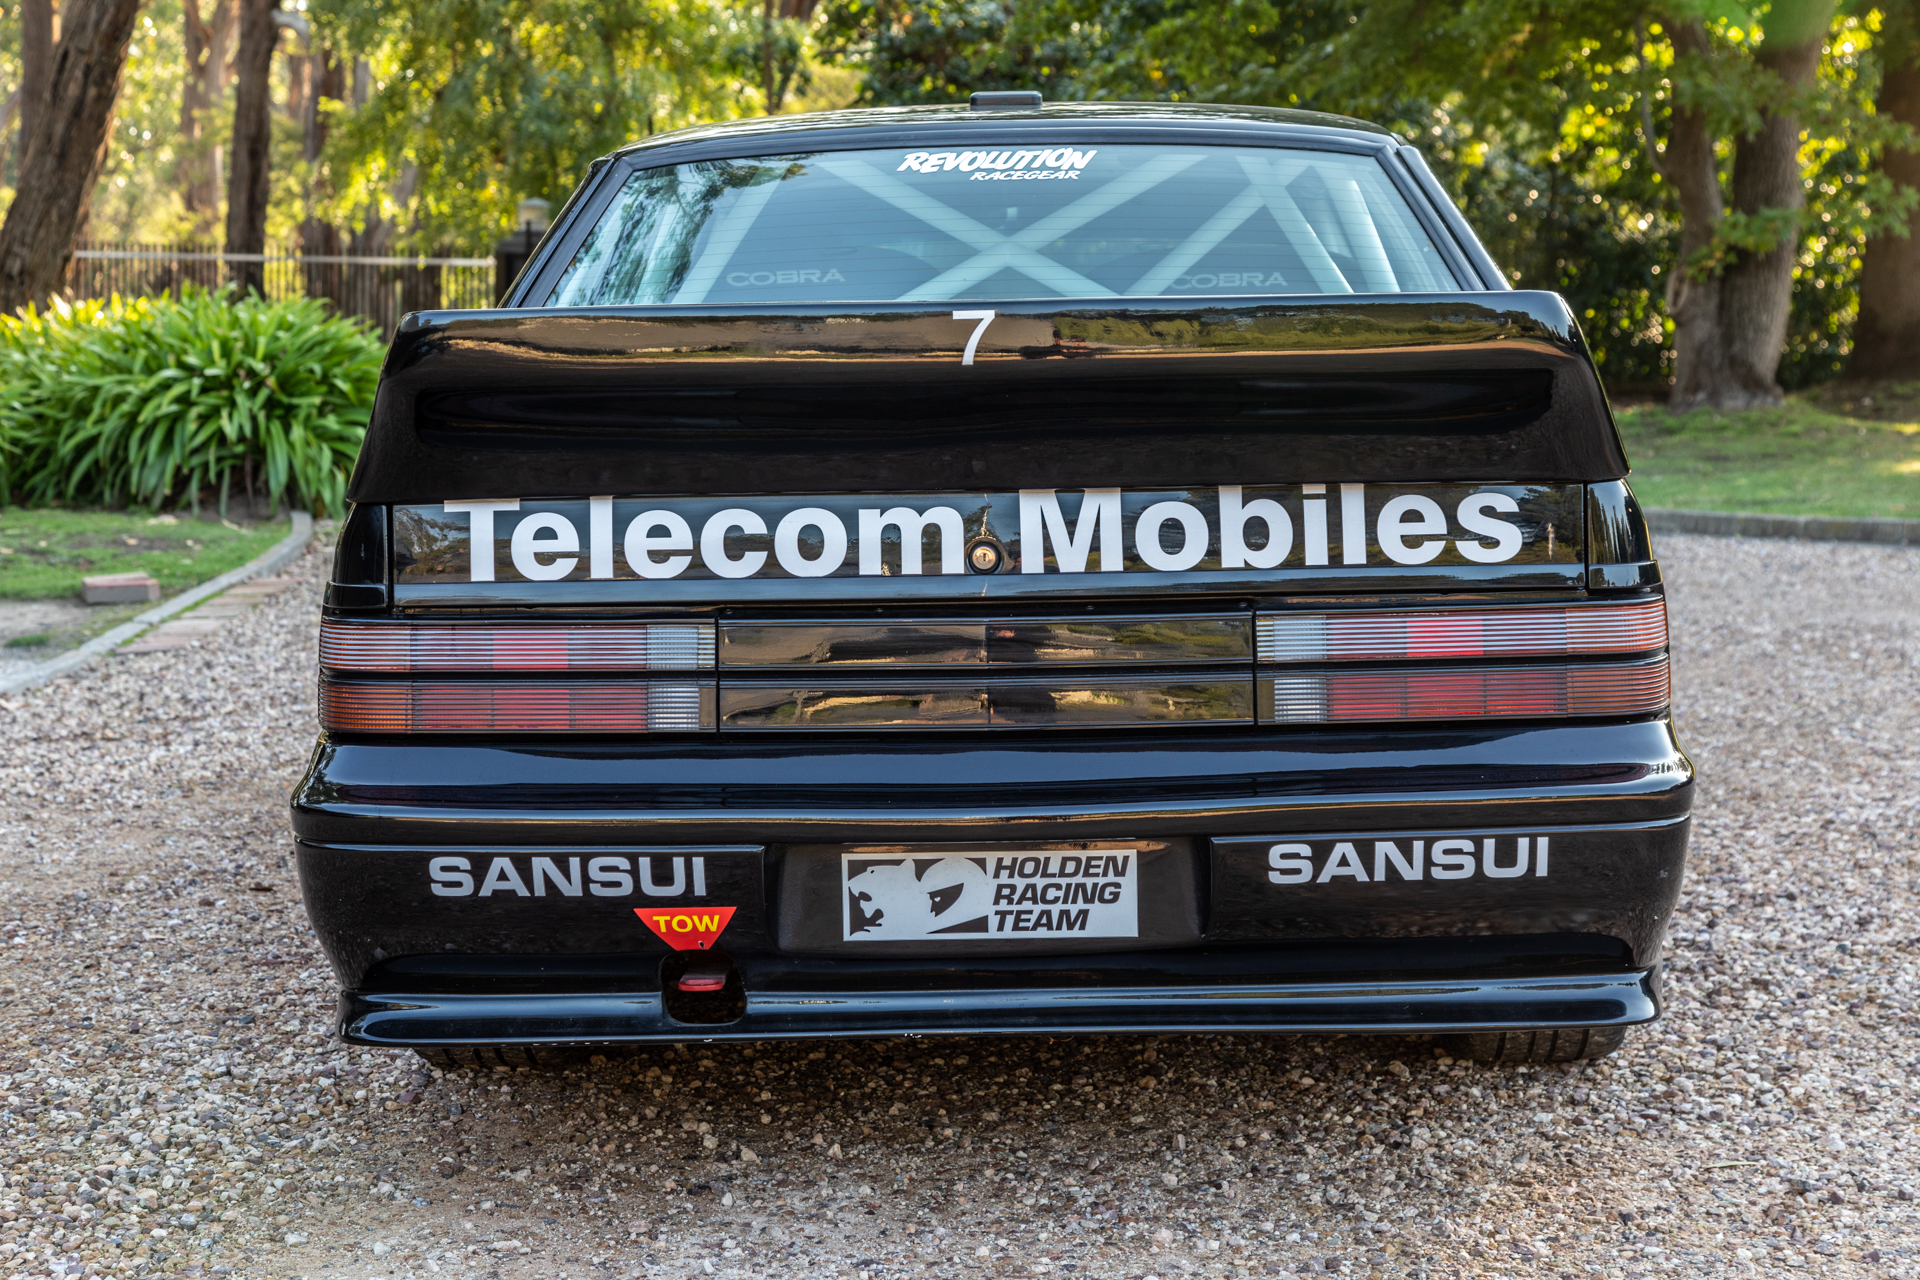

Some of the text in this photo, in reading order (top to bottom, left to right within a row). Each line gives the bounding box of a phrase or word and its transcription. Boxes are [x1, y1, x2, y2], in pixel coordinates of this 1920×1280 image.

[897, 147, 1097, 174] REVOLUTION
[969, 169, 1081, 182] RACEGEAR
[727, 268, 846, 287] COBRA
[1170, 271, 1290, 289] COBRA
[952, 310, 995, 366] 7
[444, 483, 1523, 582] Telecom Mobiles
[993, 855, 1130, 879] HOLDEN
[1268, 837, 1549, 884] SANSUI
[429, 856, 707, 898] SANSUI
[993, 881, 1122, 906] RACING
[652, 913, 720, 933] TOW
[993, 908, 1091, 932] TEAM
